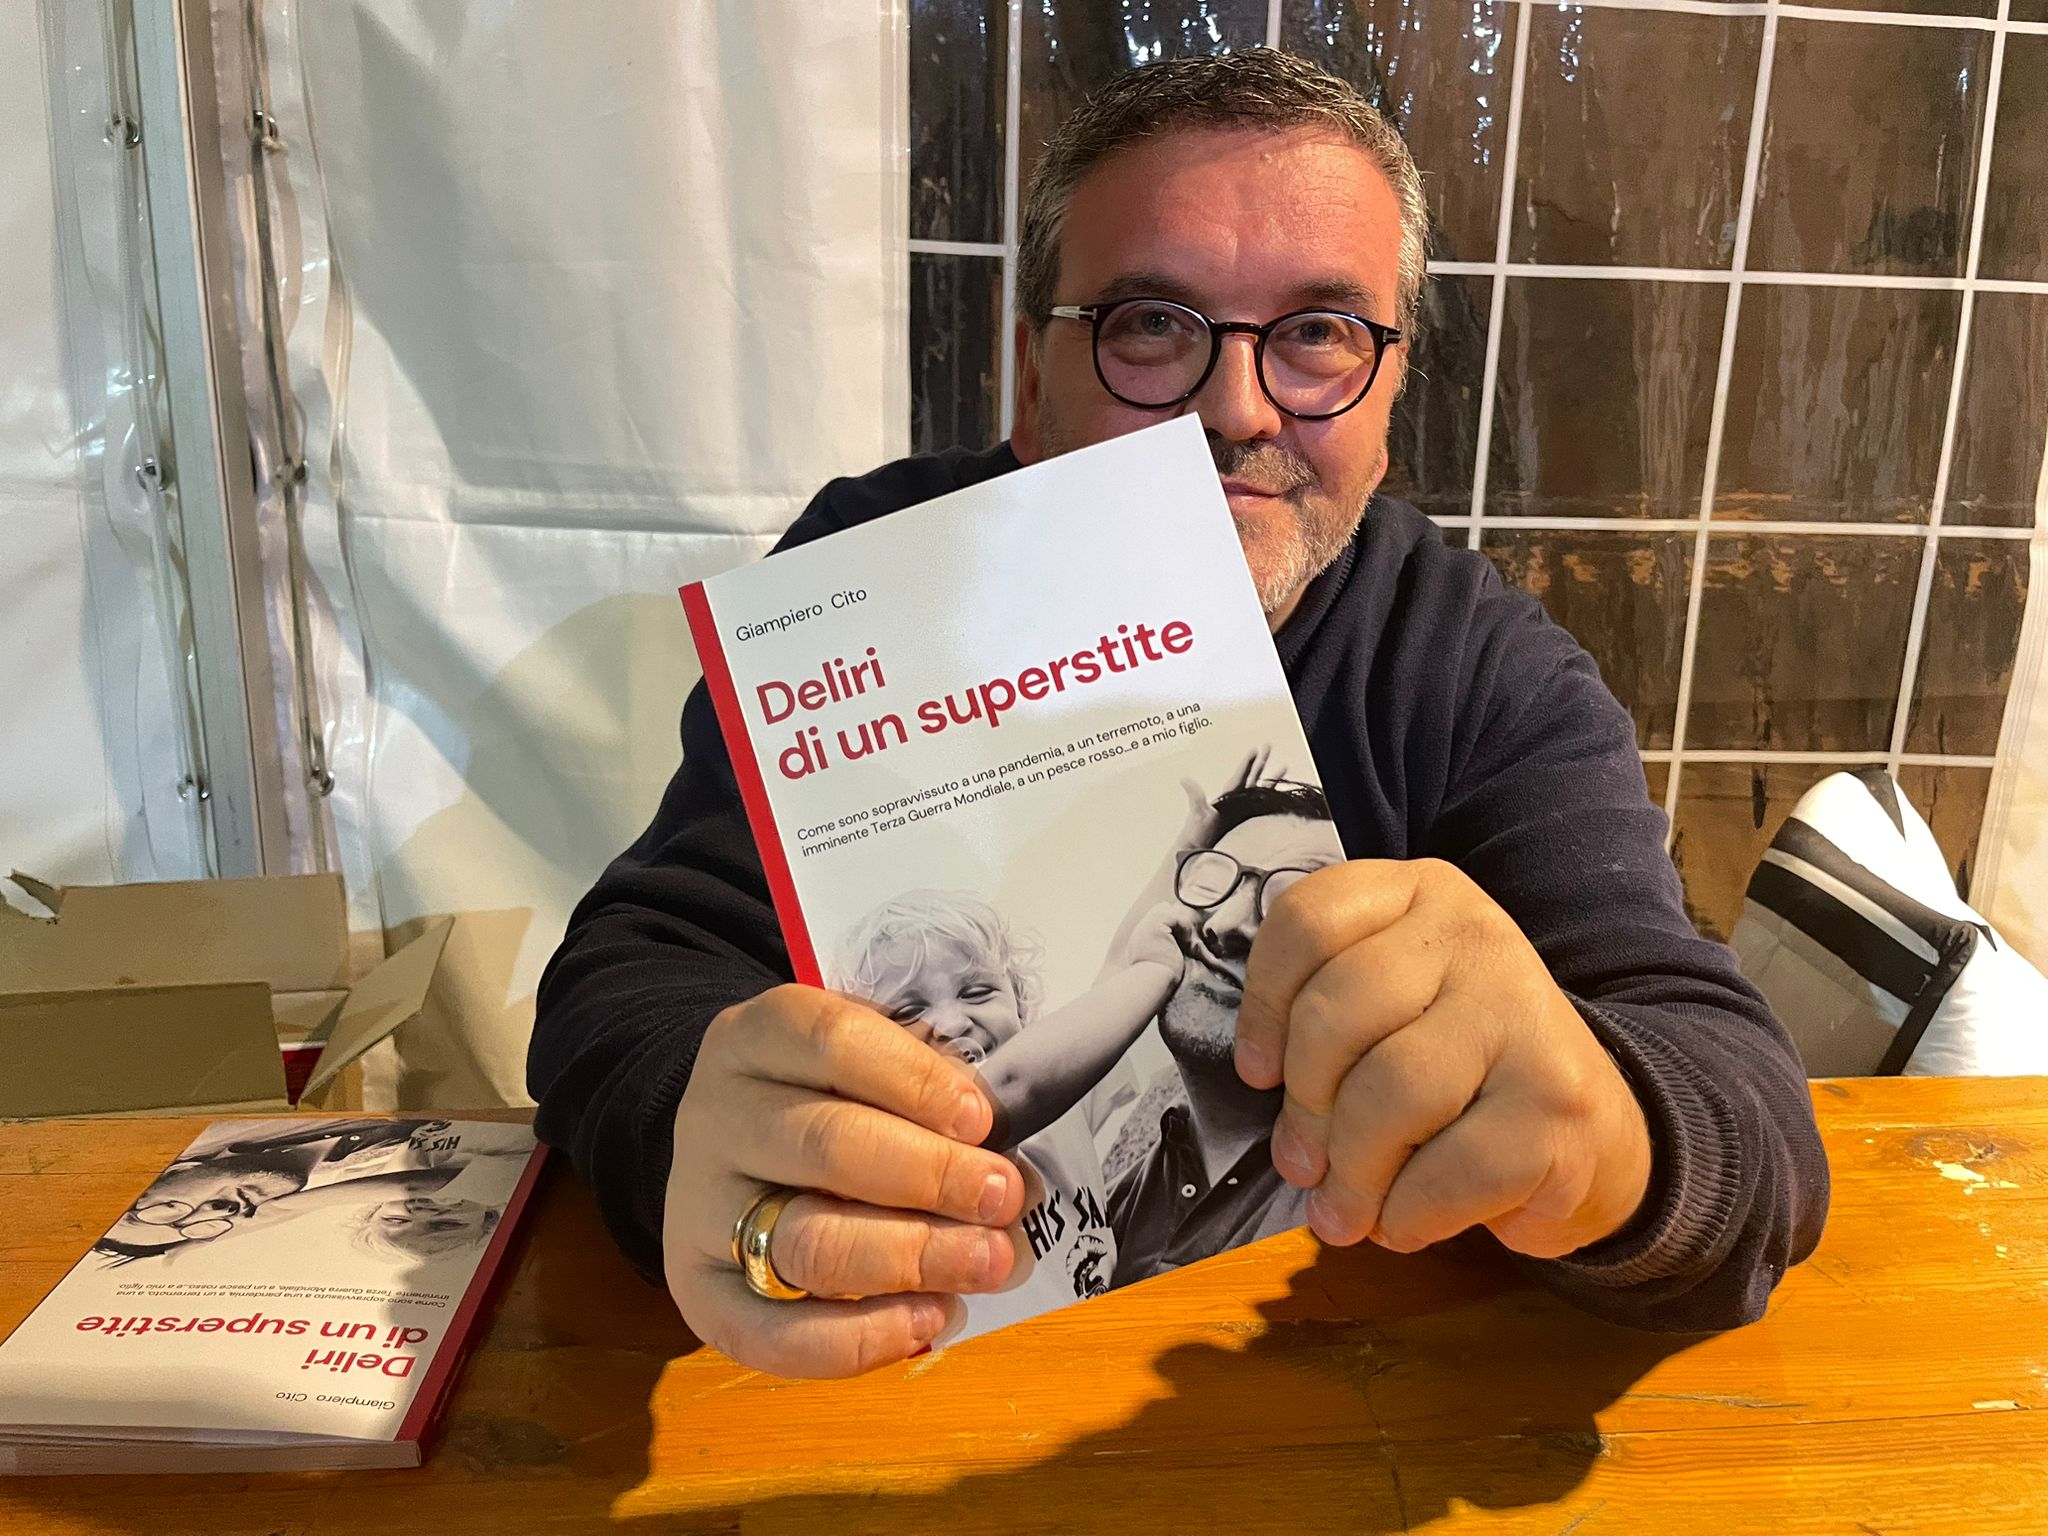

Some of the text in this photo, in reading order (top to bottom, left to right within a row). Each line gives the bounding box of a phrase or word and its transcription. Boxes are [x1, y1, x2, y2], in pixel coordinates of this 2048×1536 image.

[736, 587, 867, 642] Giampiero Cito
[756, 647, 886, 726] Deliri
[778, 619, 1194, 780] di un superstite
[797, 702, 1200, 840] Come sono sopravvissuto a una pandemia, a un terremoto, a una
[802, 828, 869, 857] imminente
[870, 816, 906, 834] Terza
[908, 800, 952, 822] Guerra
[954, 780, 1015, 807] Mondiale,
[1017, 776, 1025, 787] a
[1028, 770, 1045, 784] un
[1047, 758, 1086, 779] pesce
[1142, 736, 1150, 747] a
[1152, 727, 1176, 744] mio
[1179, 716, 1213, 735] figlio.
[76, 1312, 429, 1348] di un superstite
[301, 1349, 416, 1377] Deliri
[276, 1391, 396, 1410] Giampiero Cito
